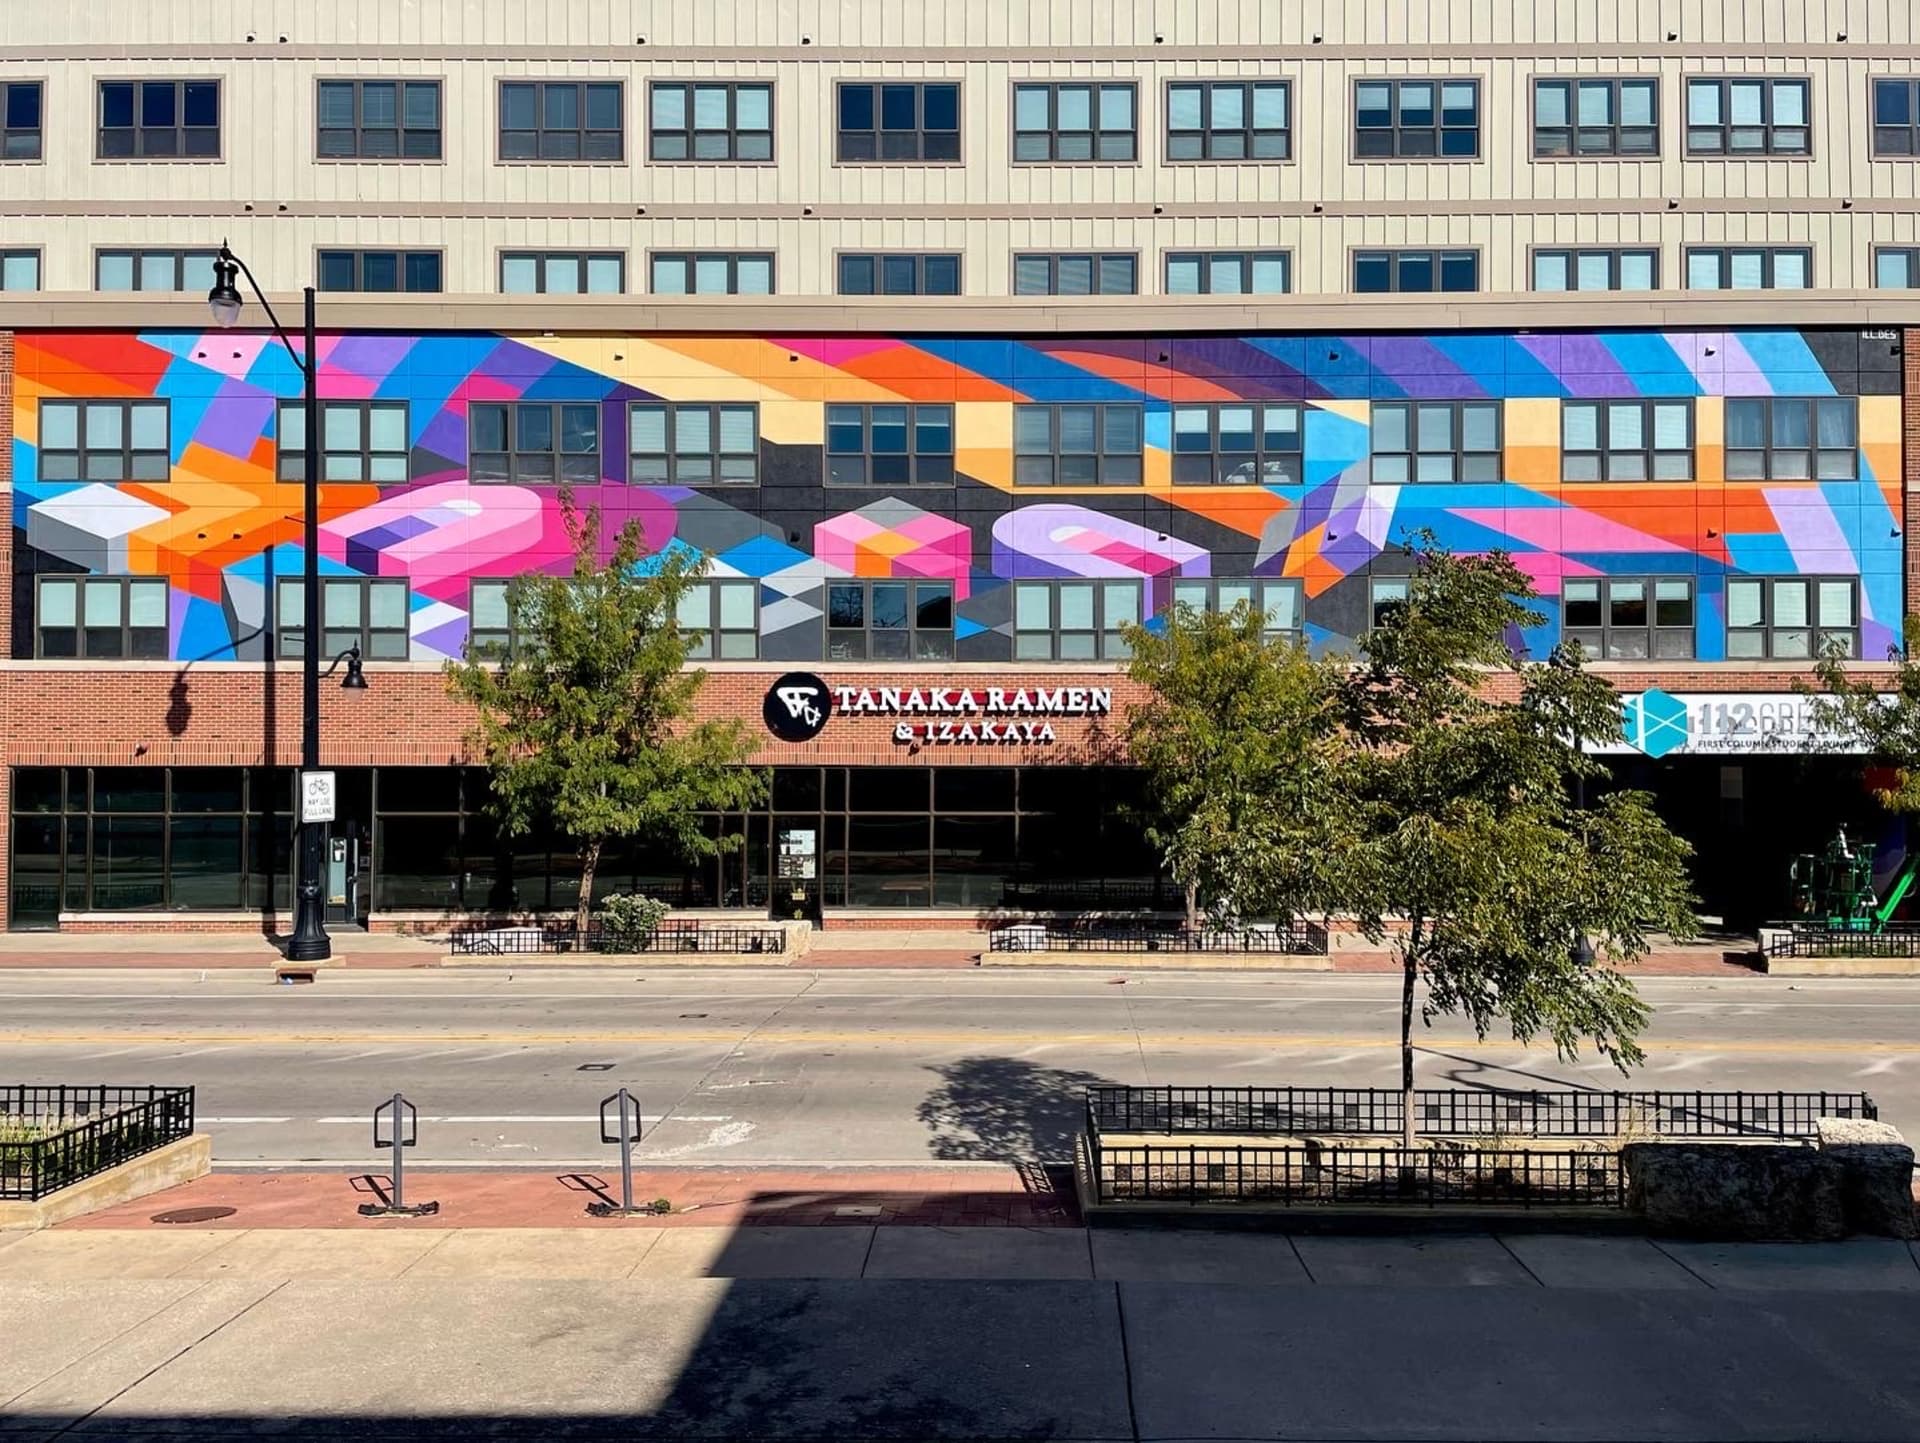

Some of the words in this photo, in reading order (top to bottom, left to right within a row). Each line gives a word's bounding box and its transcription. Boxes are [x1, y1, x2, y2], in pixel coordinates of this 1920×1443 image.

[834, 687, 977, 711] TANAKA
[986, 687, 1111, 711] RAMEN
[895, 721, 914, 740] &
[926, 721, 1056, 740] IZAKAYA
